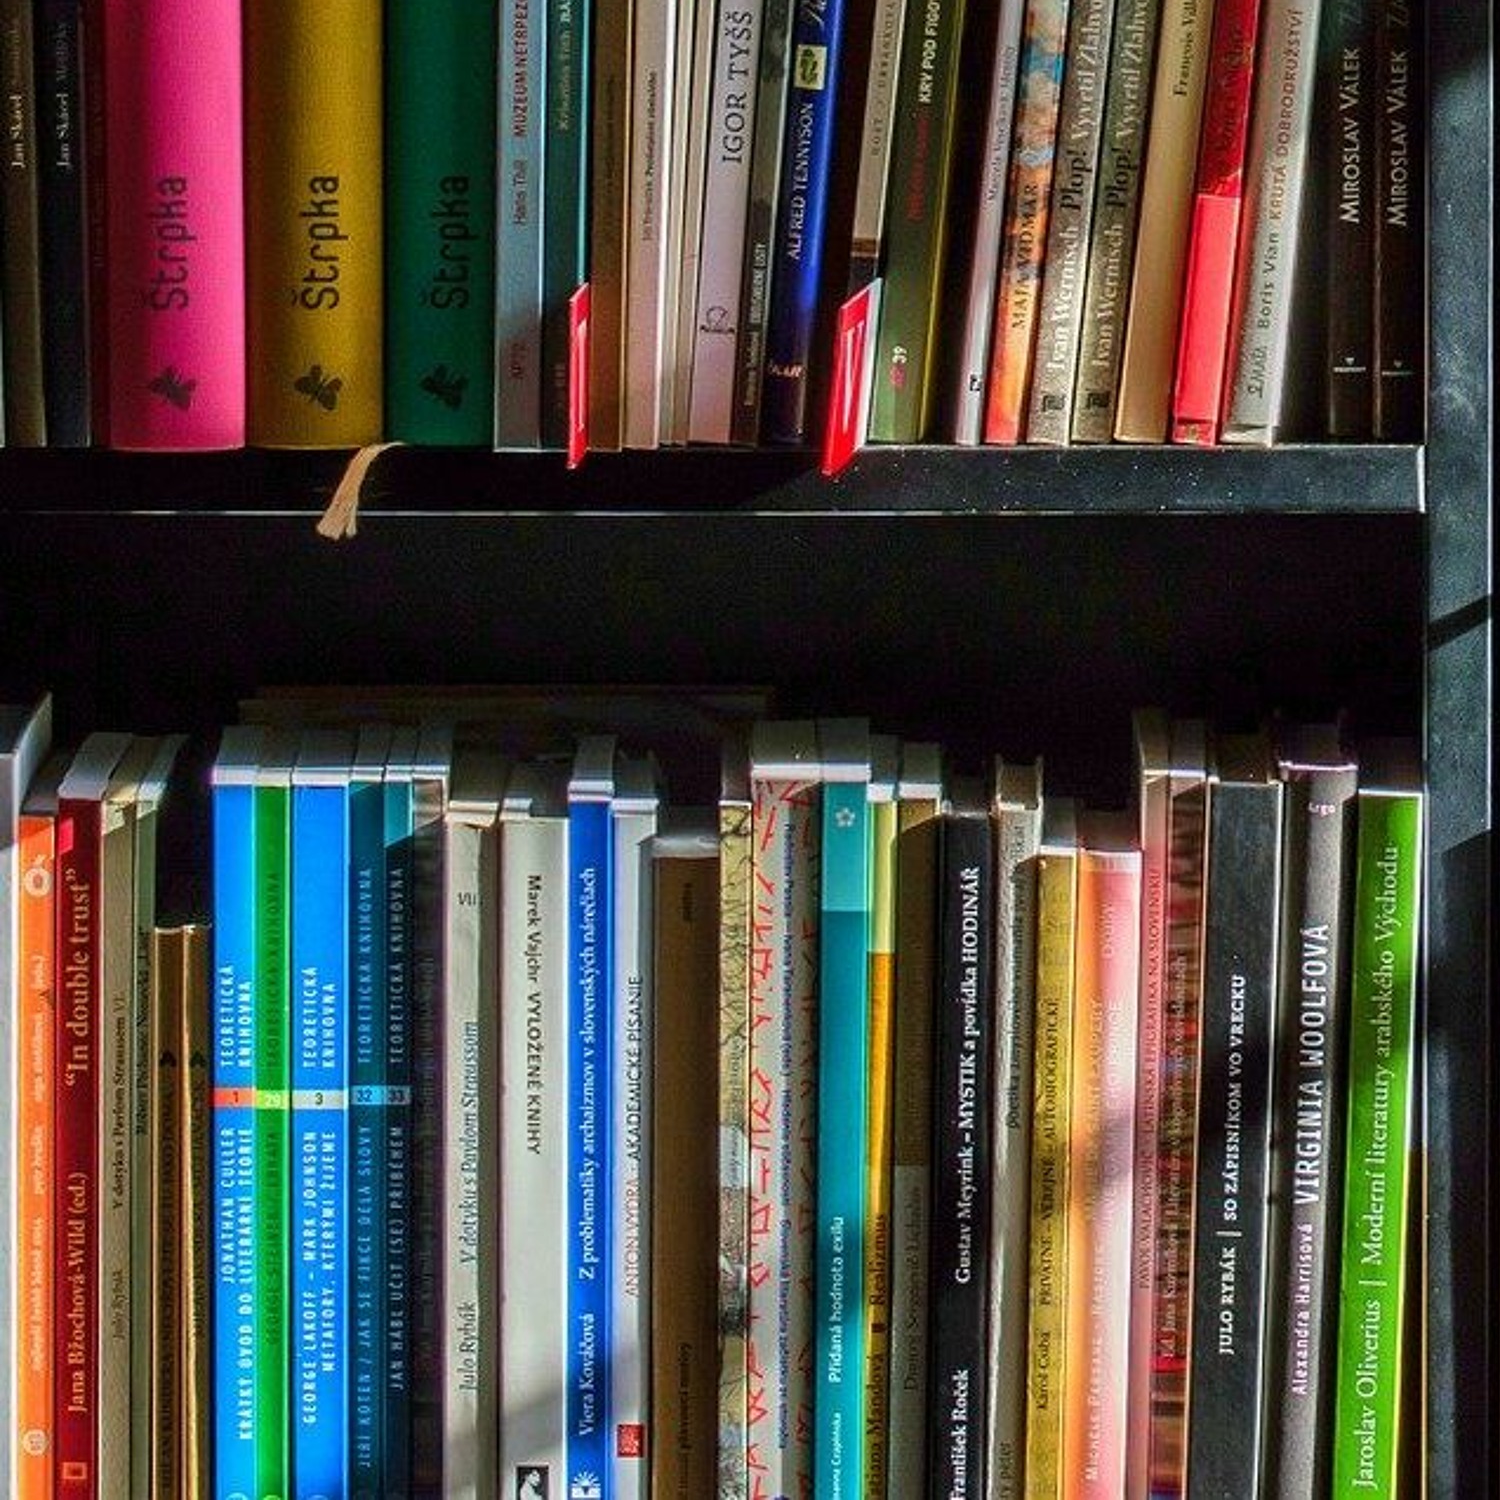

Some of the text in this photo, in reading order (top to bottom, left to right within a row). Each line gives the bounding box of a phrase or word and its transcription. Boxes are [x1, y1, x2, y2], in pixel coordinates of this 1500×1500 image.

[722, 89, 748, 165] IGOR
[1058, 145, 1092, 212] Plop!
[1338, 48, 1360, 224] MIROSLAV VÁLEK
[1386, 49, 1407, 228] MIROSLAV VÁLEK
[144, 173, 197, 311] Štrpka
[292, 173, 351, 311] Štrpka
[786, 197, 806, 261] ALFRED
[1257, 231, 1281, 330] Boris Vian
[66, 951, 90, 1042] double
[321, 982, 336, 1068] KNIHOVNA
[523, 874, 544, 1154] Marek Vajchr VYLOŽENÉ KNIHY
[578, 946, 601, 1044] slovenských
[314, 1091, 324, 1105] 3
[578, 1065, 597, 1148] archaizmov
[957, 1052, 977, 1131] MYSTIK
[220, 1126, 234, 1284] JONATHAN CULLER
[578, 1150, 602, 1264] problematiky
[1218, 972, 1247, 1355] JULO RYBÁK VO VRECKU
[1292, 921, 1329, 1395] Alexandra Harrisová VIRGINIA WOOLFOVÁ
[1352, 845, 1403, 1490] Jaroslav Oliverius Moderní literatury arabského Východu
[302, 1131, 317, 1424] GEORGE LAKOFF JOHNSON
[828, 1215, 845, 1384] Přidaná hodnota exilu
[954, 1224, 973, 1285] Gustav
[68, 1370, 88, 1413] Jana
